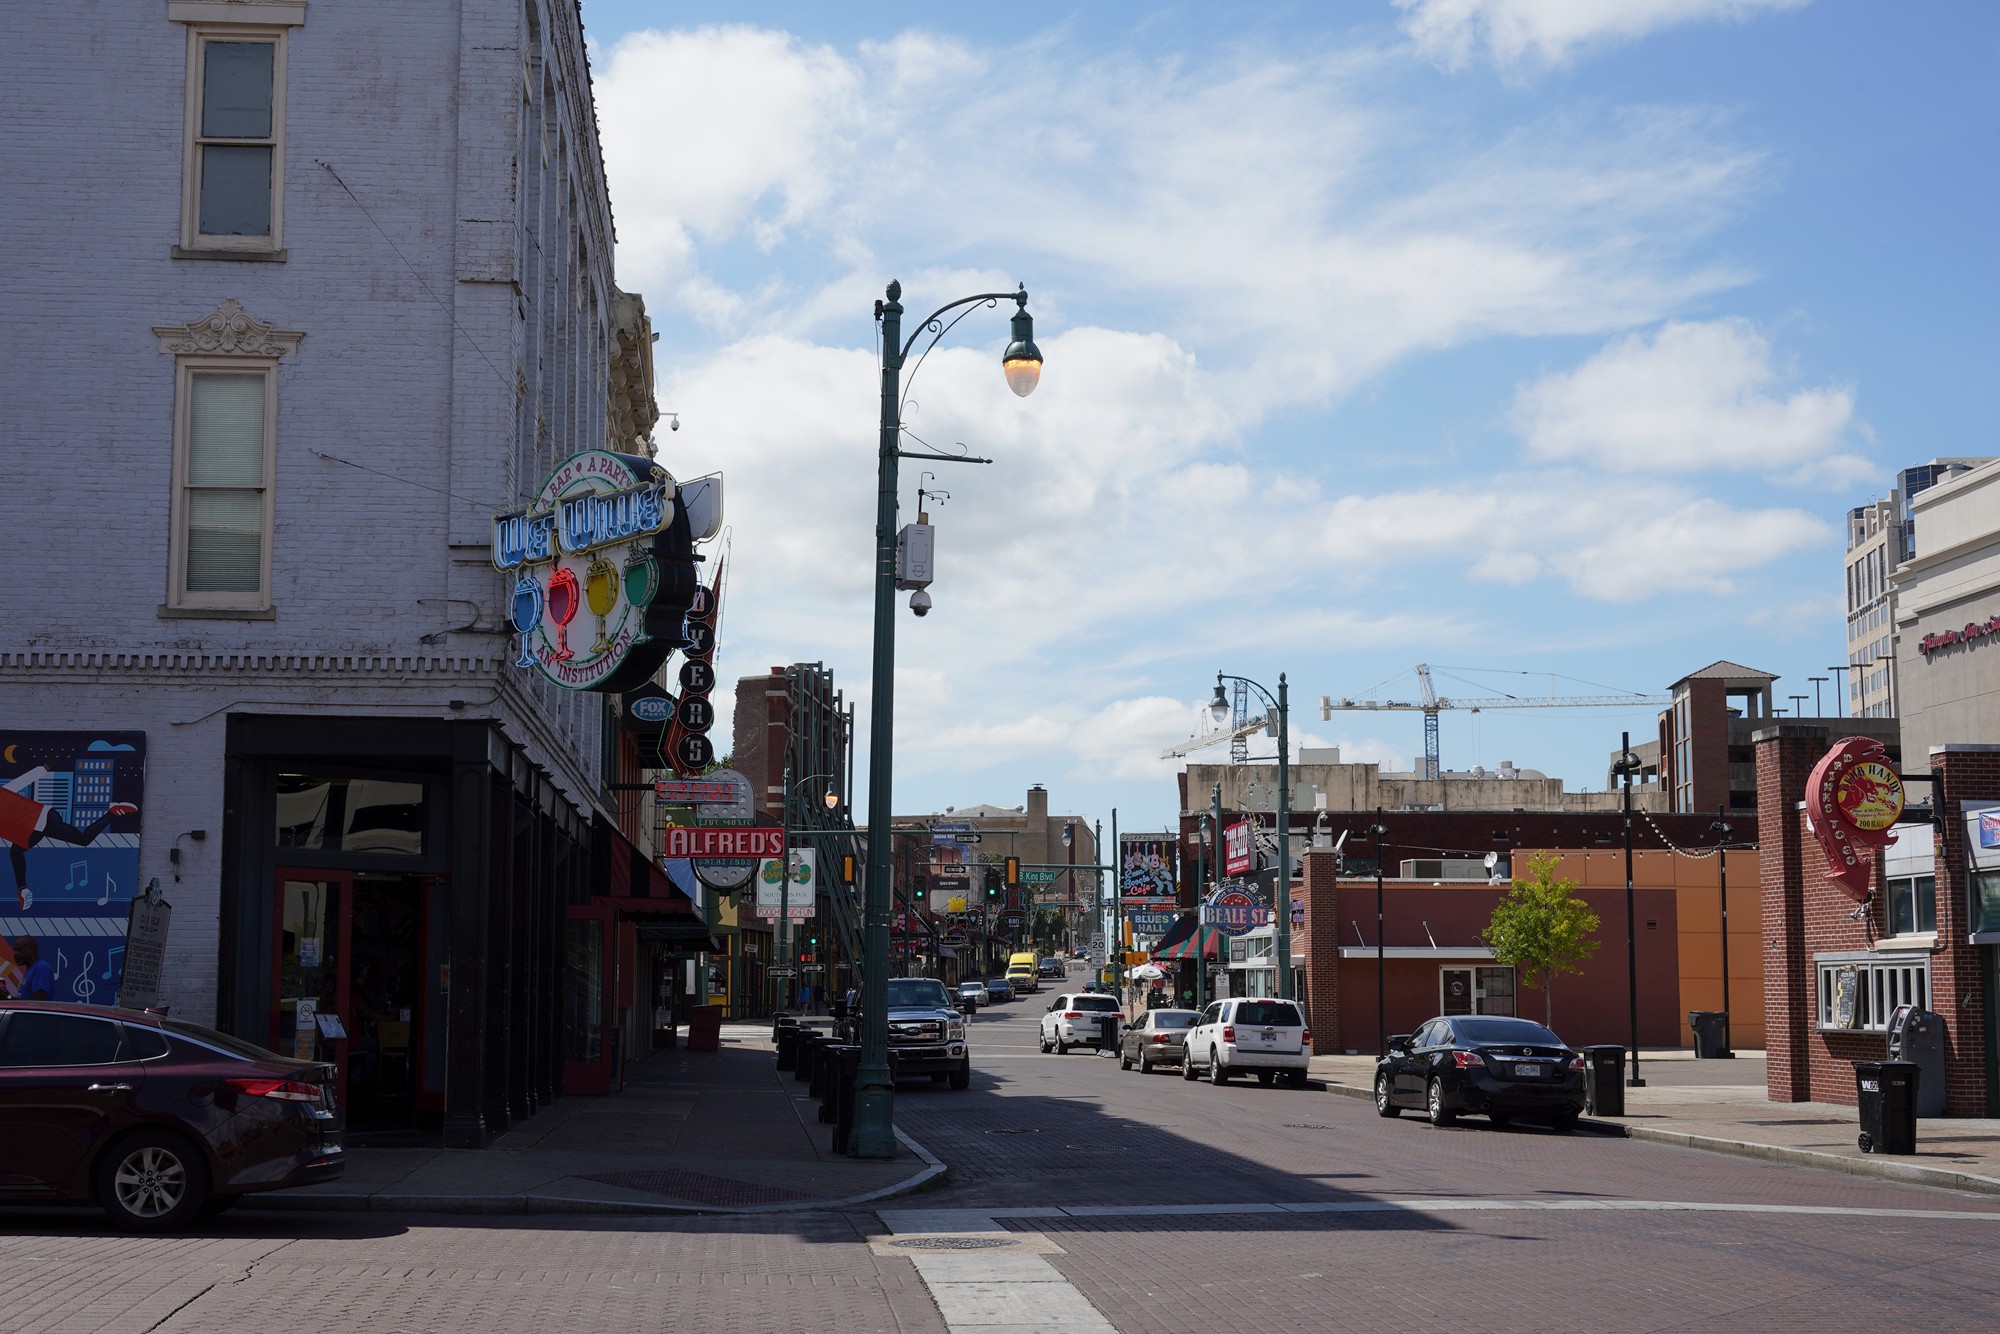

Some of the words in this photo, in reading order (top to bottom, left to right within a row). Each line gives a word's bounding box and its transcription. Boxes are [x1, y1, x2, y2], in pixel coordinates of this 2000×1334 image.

[540, 498, 550, 511] A
[549, 467, 573, 498] BAR
[586, 456, 597, 473] A
[495, 516, 556, 569] WET
[1918, 629, 1959, 656] Hampton
[1959, 622, 1981, 643] Inn
[536, 645, 552, 669] AN
[556, 628, 632, 684] INSTITUTION
[639, 701, 667, 713] FOX
[1842, 766, 1866, 792] CLUB
[1868, 764, 1902, 796] HANDY
[723, 818, 753, 827] MUSIC
[669, 829, 784, 856] ALFRED'S
[698, 858, 726, 866] GREAT
[1026, 872, 1039, 881] King
[1039, 872, 1053, 881] Blvd.
[1124, 869, 1146, 880] Rum
[1135, 914, 1169, 924] BLUES
[1205, 907, 1247, 924] BEALE
[1138, 924, 1165, 933] HALL
[1223, 926, 1250, 937] GIFTS
[1092, 941, 1104, 949] 20
